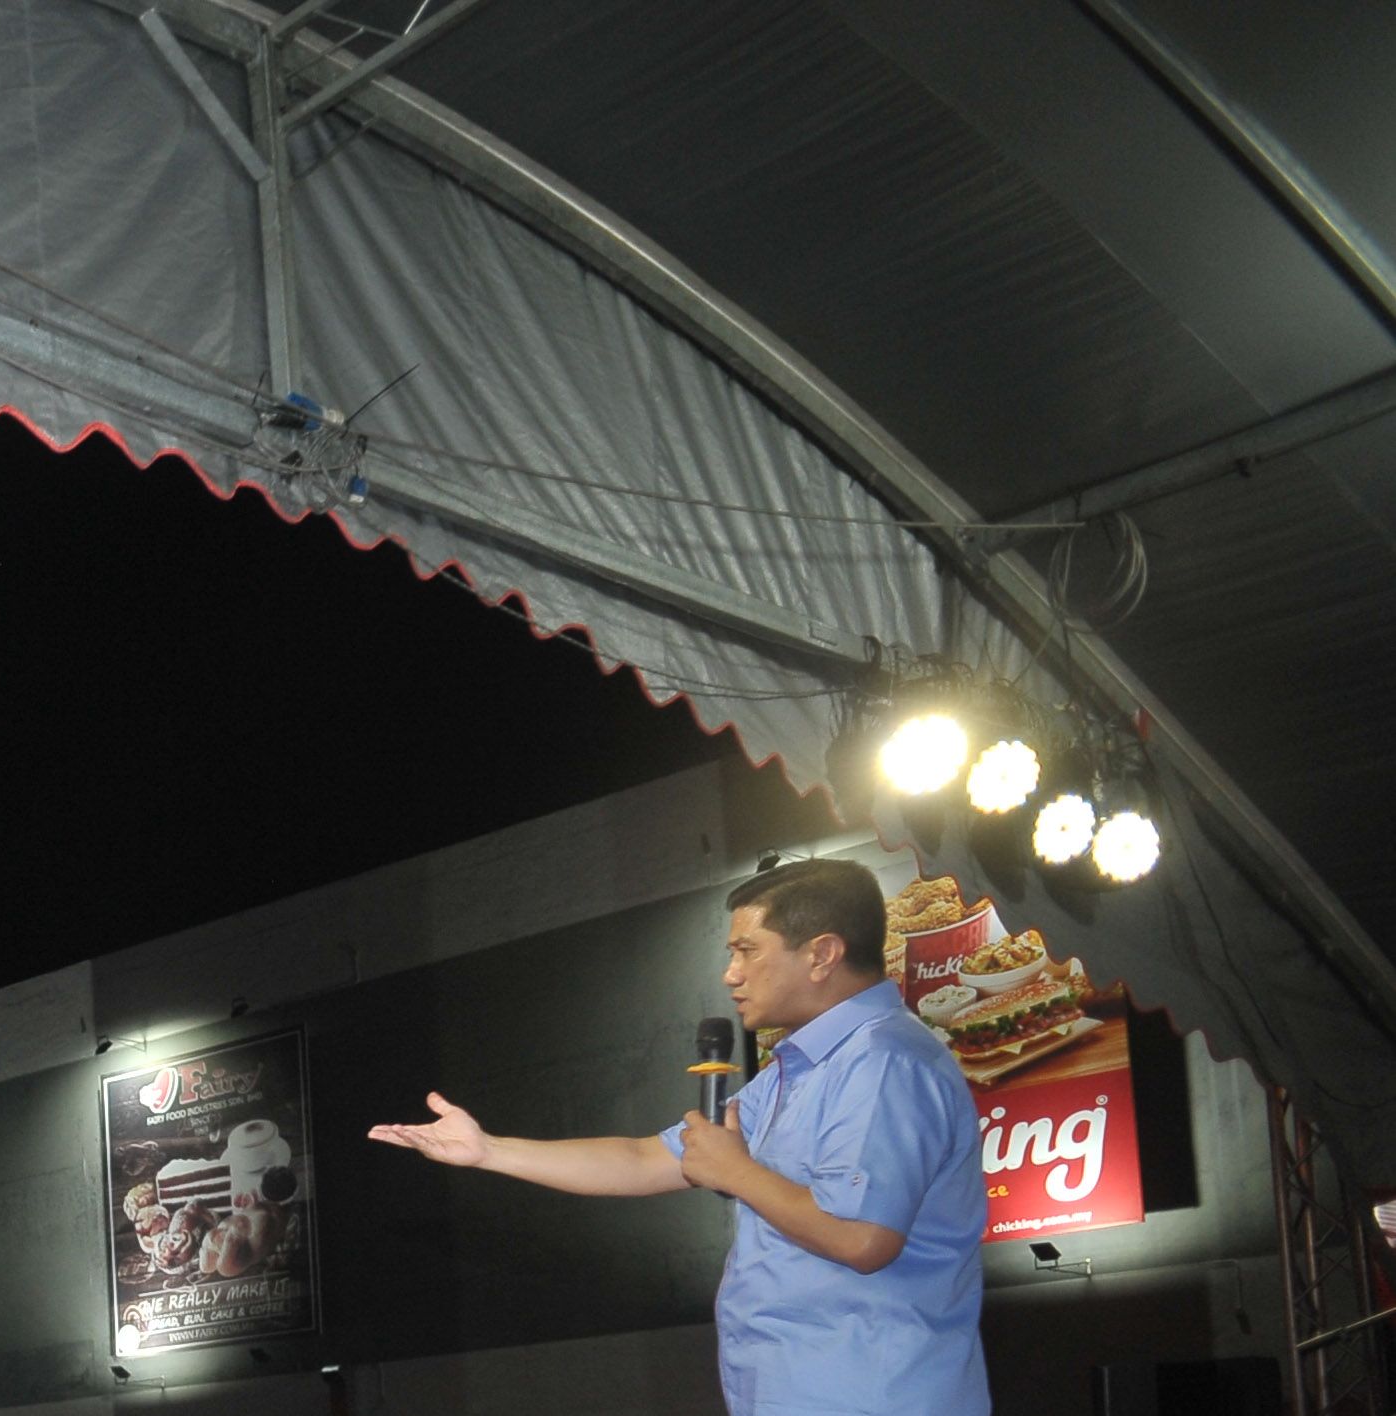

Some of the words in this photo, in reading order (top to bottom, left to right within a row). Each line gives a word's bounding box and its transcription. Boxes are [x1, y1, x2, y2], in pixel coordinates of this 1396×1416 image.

[178, 1059, 263, 1105] Fairy
[166, 1109, 186, 1121] FOOD
[169, 1288, 221, 1310] REALLY
[227, 1281, 269, 1299] MAKE
[210, 1309, 235, 1321] CAKE
[238, 1306, 246, 1316] &
